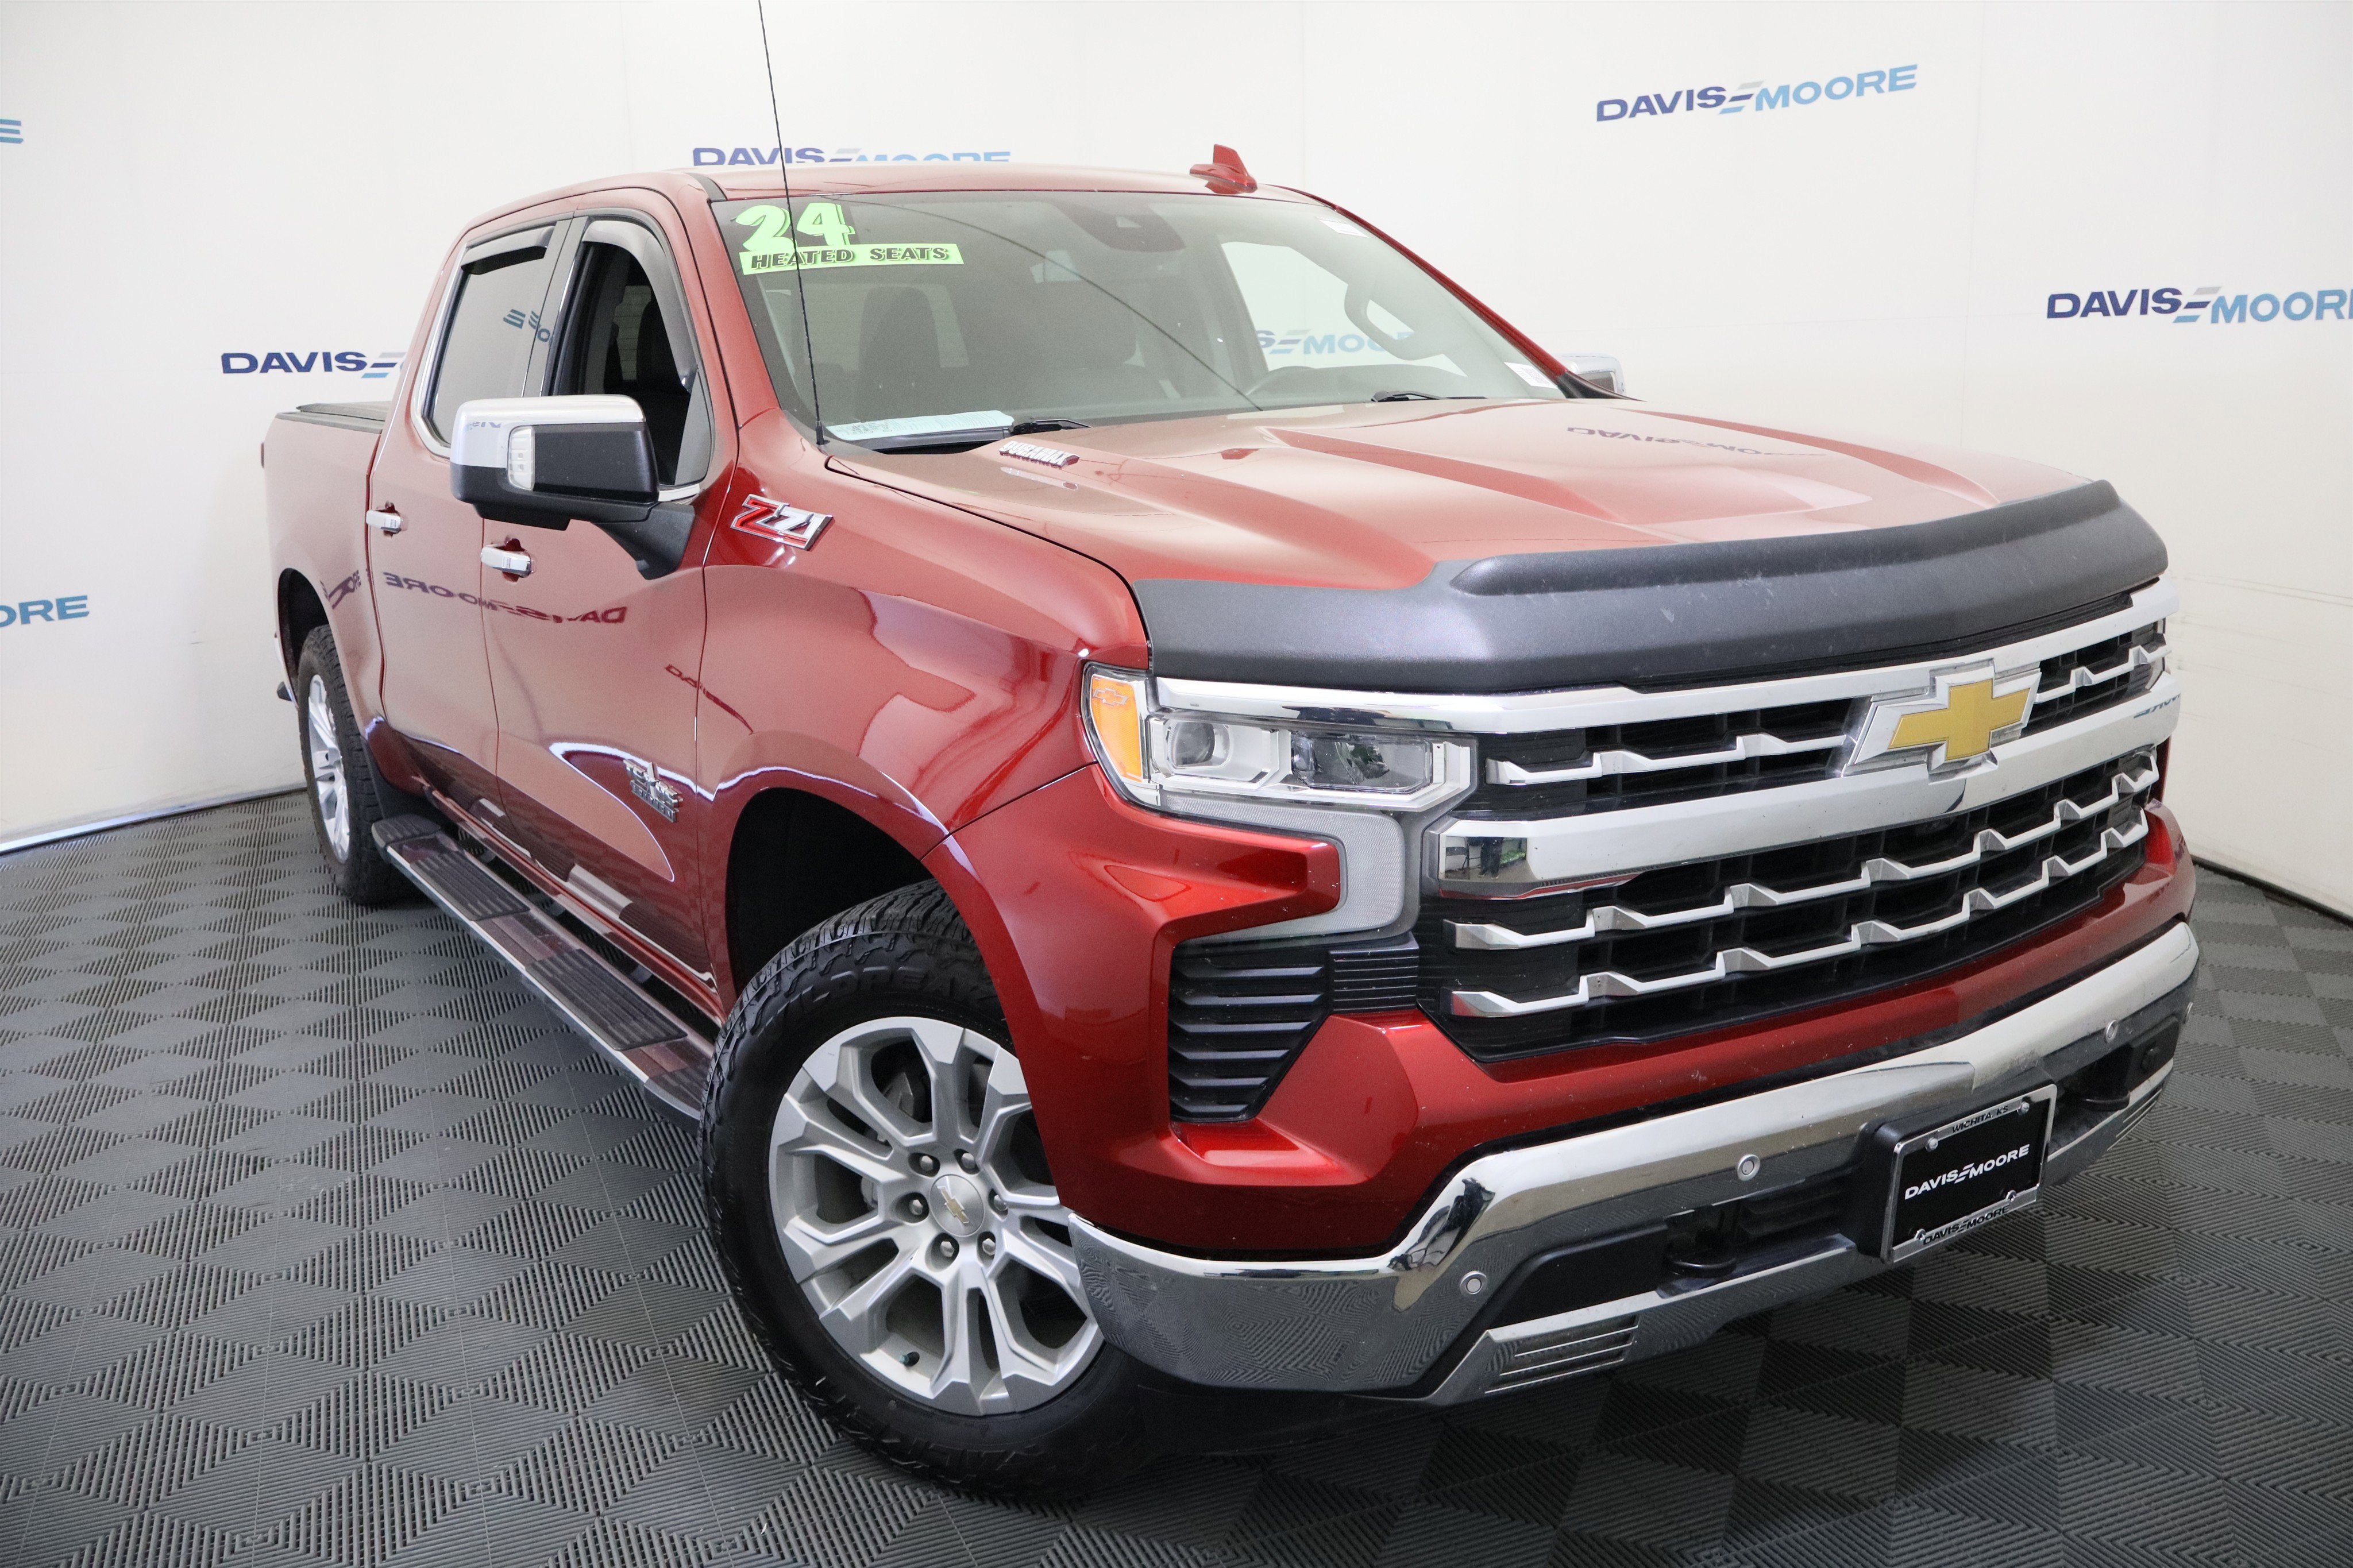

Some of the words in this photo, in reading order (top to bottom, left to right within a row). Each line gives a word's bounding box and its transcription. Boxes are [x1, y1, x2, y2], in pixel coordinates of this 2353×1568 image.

[1596, 86, 1726, 122] DAVIS
[1755, 64, 1918, 111] MOORE
[693, 148, 825, 166] DAVIS
[735, 202, 855, 252] 24
[751, 249, 854, 271] HEATED
[869, 247, 949, 261] SEATS
[2047, 287, 2182, 319] DAVIS
[2211, 289, 2353, 324] MOOR
[221, 352, 367, 374] DAVIS
[1996, 1105, 2008, 1115] KS
[1904, 1169, 1959, 1200] DAVIS
[1969, 1144, 2030, 1179] MOORE
[1923, 1223, 1959, 1245] DAVIS
[1966, 1204, 2010, 1229] MOORE
